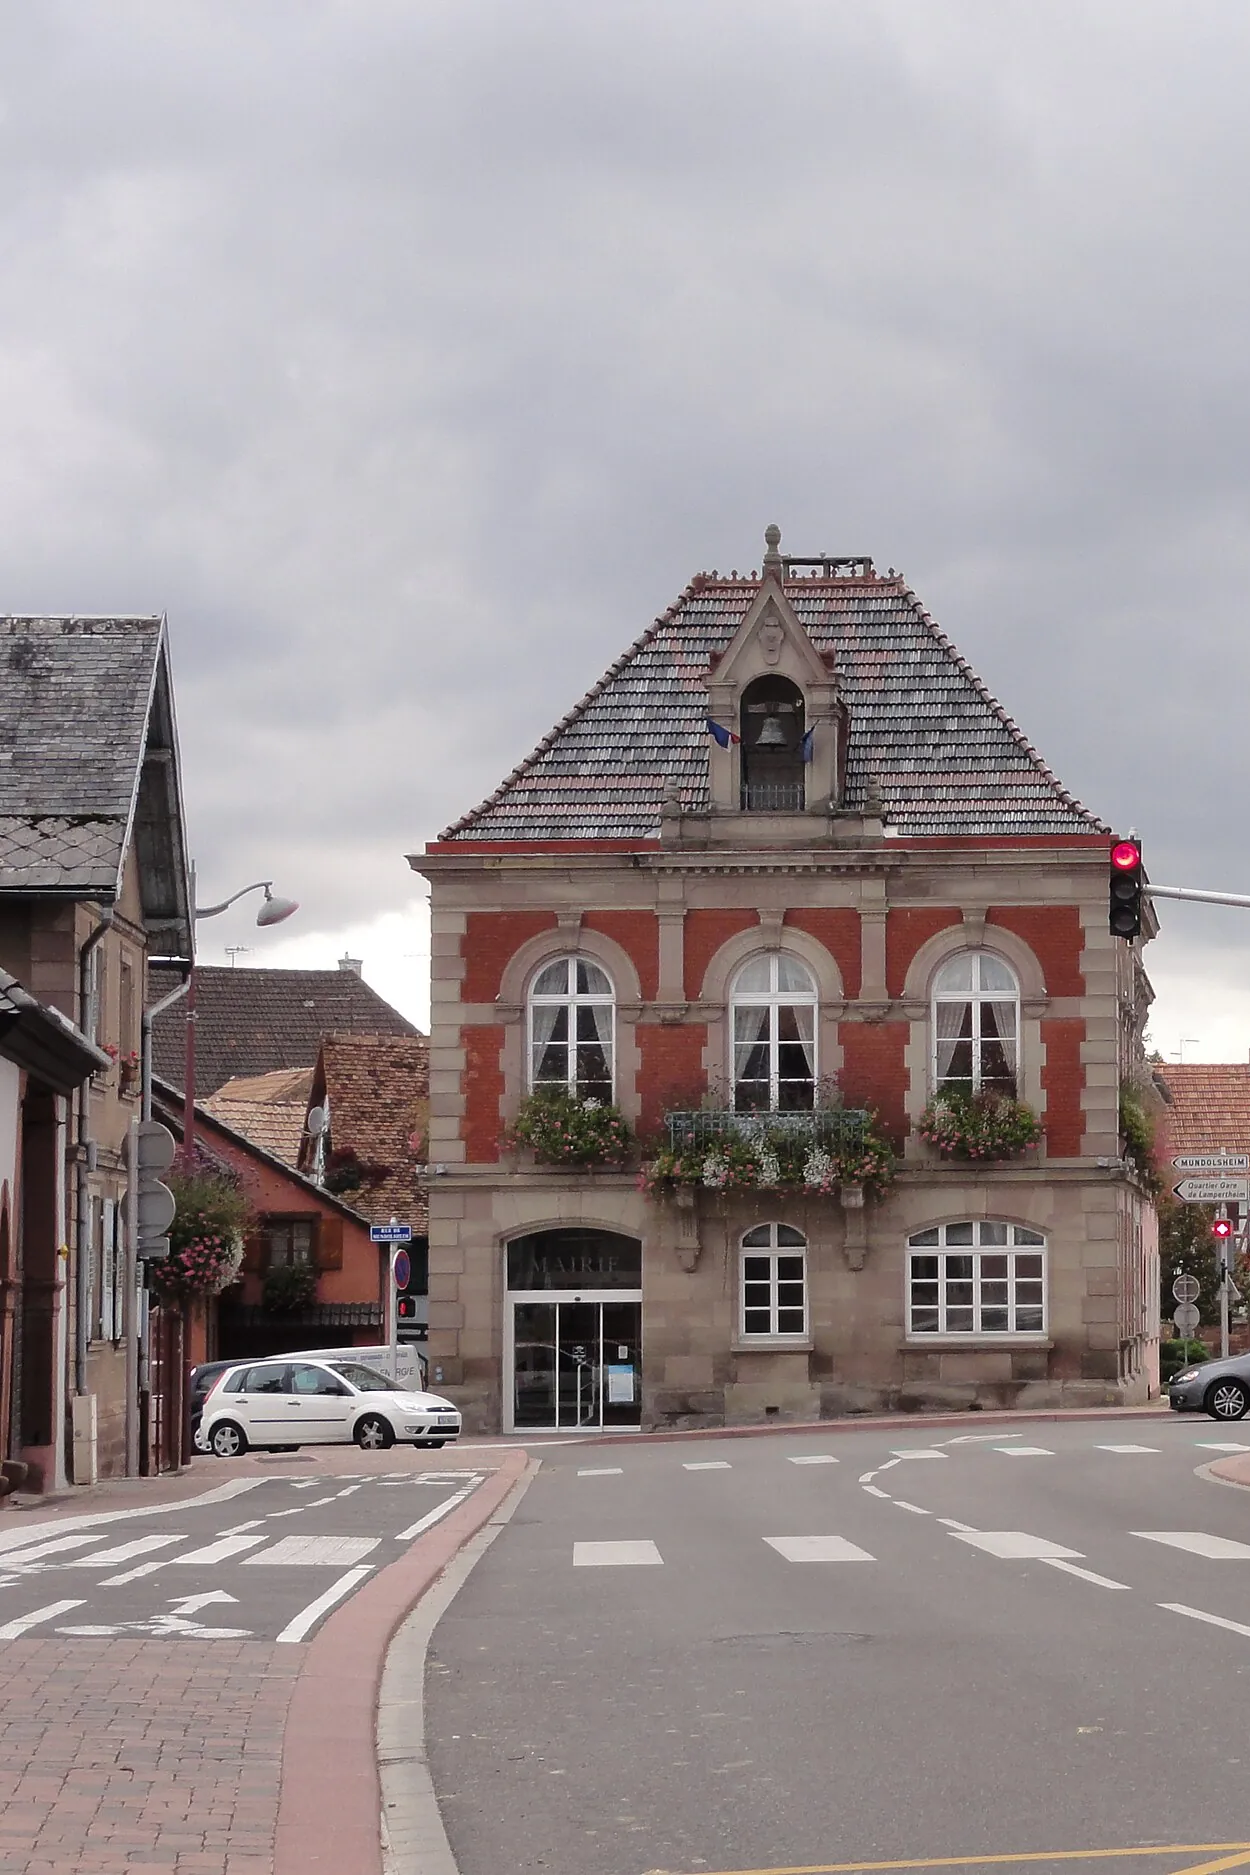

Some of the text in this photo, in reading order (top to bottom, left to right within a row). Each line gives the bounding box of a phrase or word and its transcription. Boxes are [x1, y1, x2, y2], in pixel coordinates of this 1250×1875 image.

[1181, 1158, 1245, 1167] MUNDOLSHEIM
[1187, 1181, 1238, 1189] Quartier Gare
[1198, 1191, 1246, 1199] Lampertheim
[379, 1367, 415, 1377] ENRGIE
